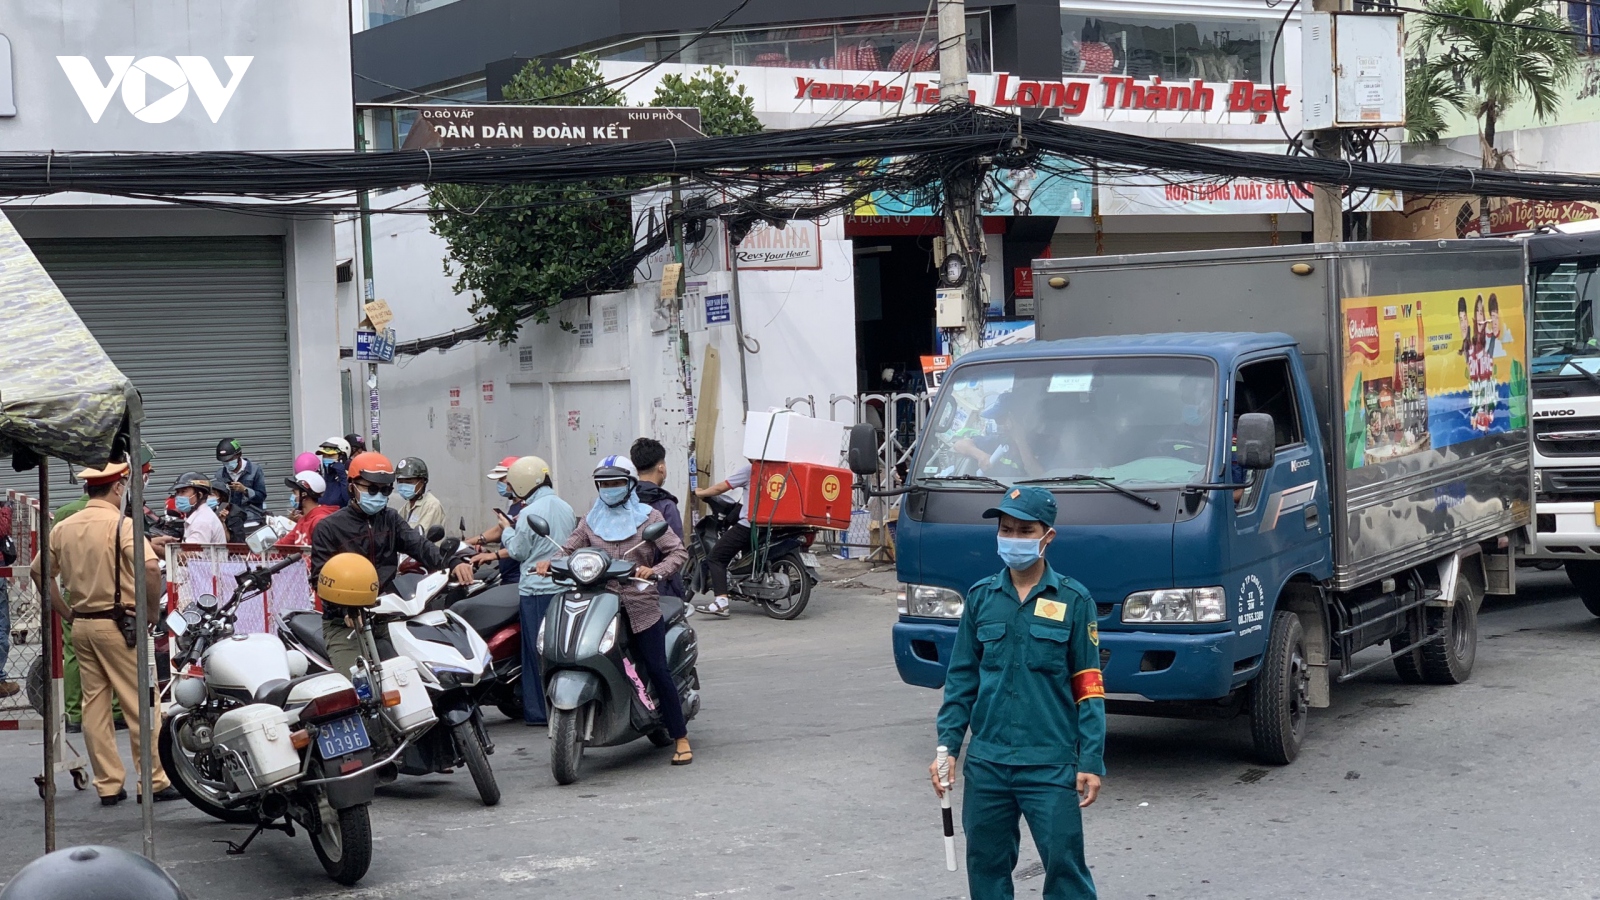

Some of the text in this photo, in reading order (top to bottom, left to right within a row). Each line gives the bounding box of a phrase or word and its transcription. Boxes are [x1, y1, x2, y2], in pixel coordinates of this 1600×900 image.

[794, 76, 903, 103] Yamaha
[993, 73, 1090, 114] Long
[1102, 75, 1214, 111] Thành
[1228, 81, 1291, 124] Đạt
[628, 112, 650, 120] KHU
[434, 121, 631, 139] OÀN DÂN ĐOÀN KẾT
[1233, 181, 1263, 200] XUẤT
[737, 227, 811, 249] AMAHA
[736, 249, 811, 262] Revs Your Heart
[1533, 409, 1576, 417] AEWOO
[824, 482, 837, 493] CP
[325, 732, 363, 755] 0396
